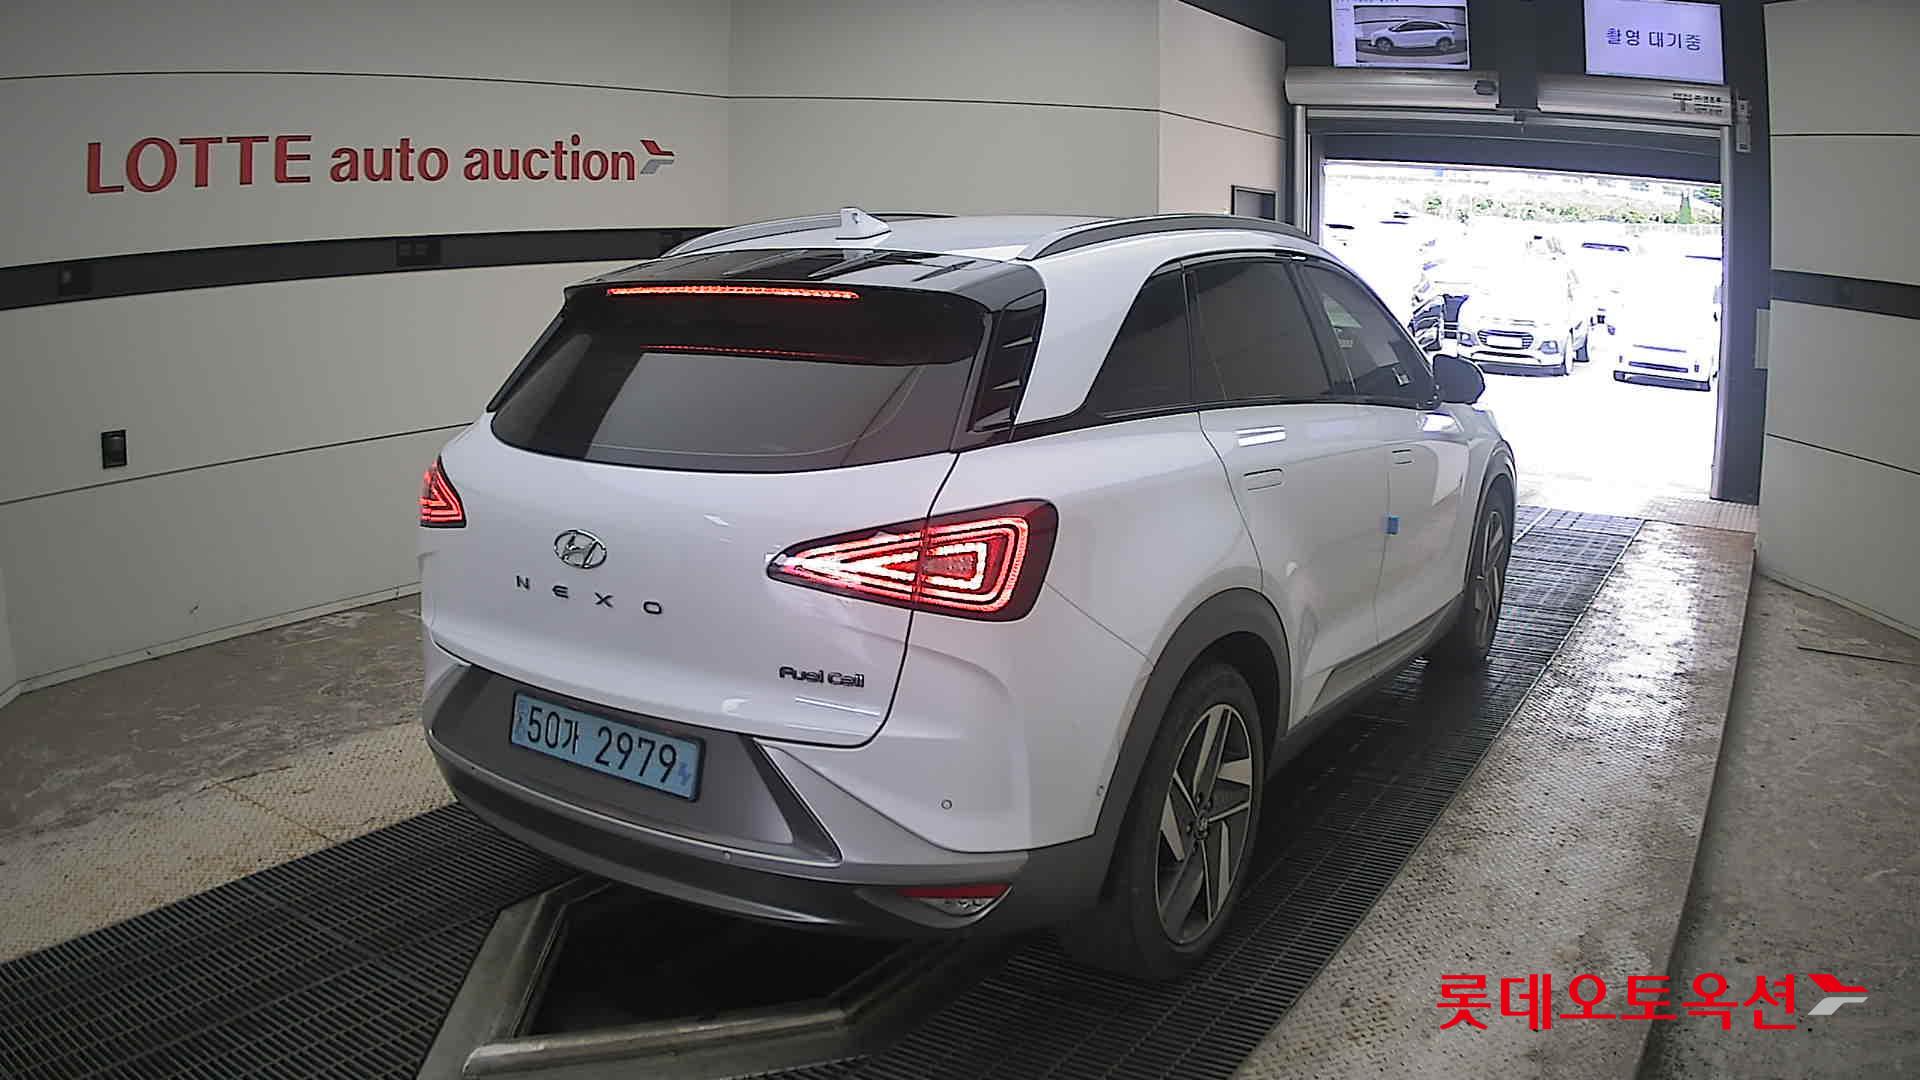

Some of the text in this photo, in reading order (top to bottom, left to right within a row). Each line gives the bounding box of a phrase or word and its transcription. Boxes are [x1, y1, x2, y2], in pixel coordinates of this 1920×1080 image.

[1647, 31, 1702, 51] 대기중
[86, 134, 636, 194] LOTTE auto auction
[515, 575, 663, 615] NEXO
[779, 666, 865, 688] Fuel Cell
[527, 705, 677, 783] 50가 2979
